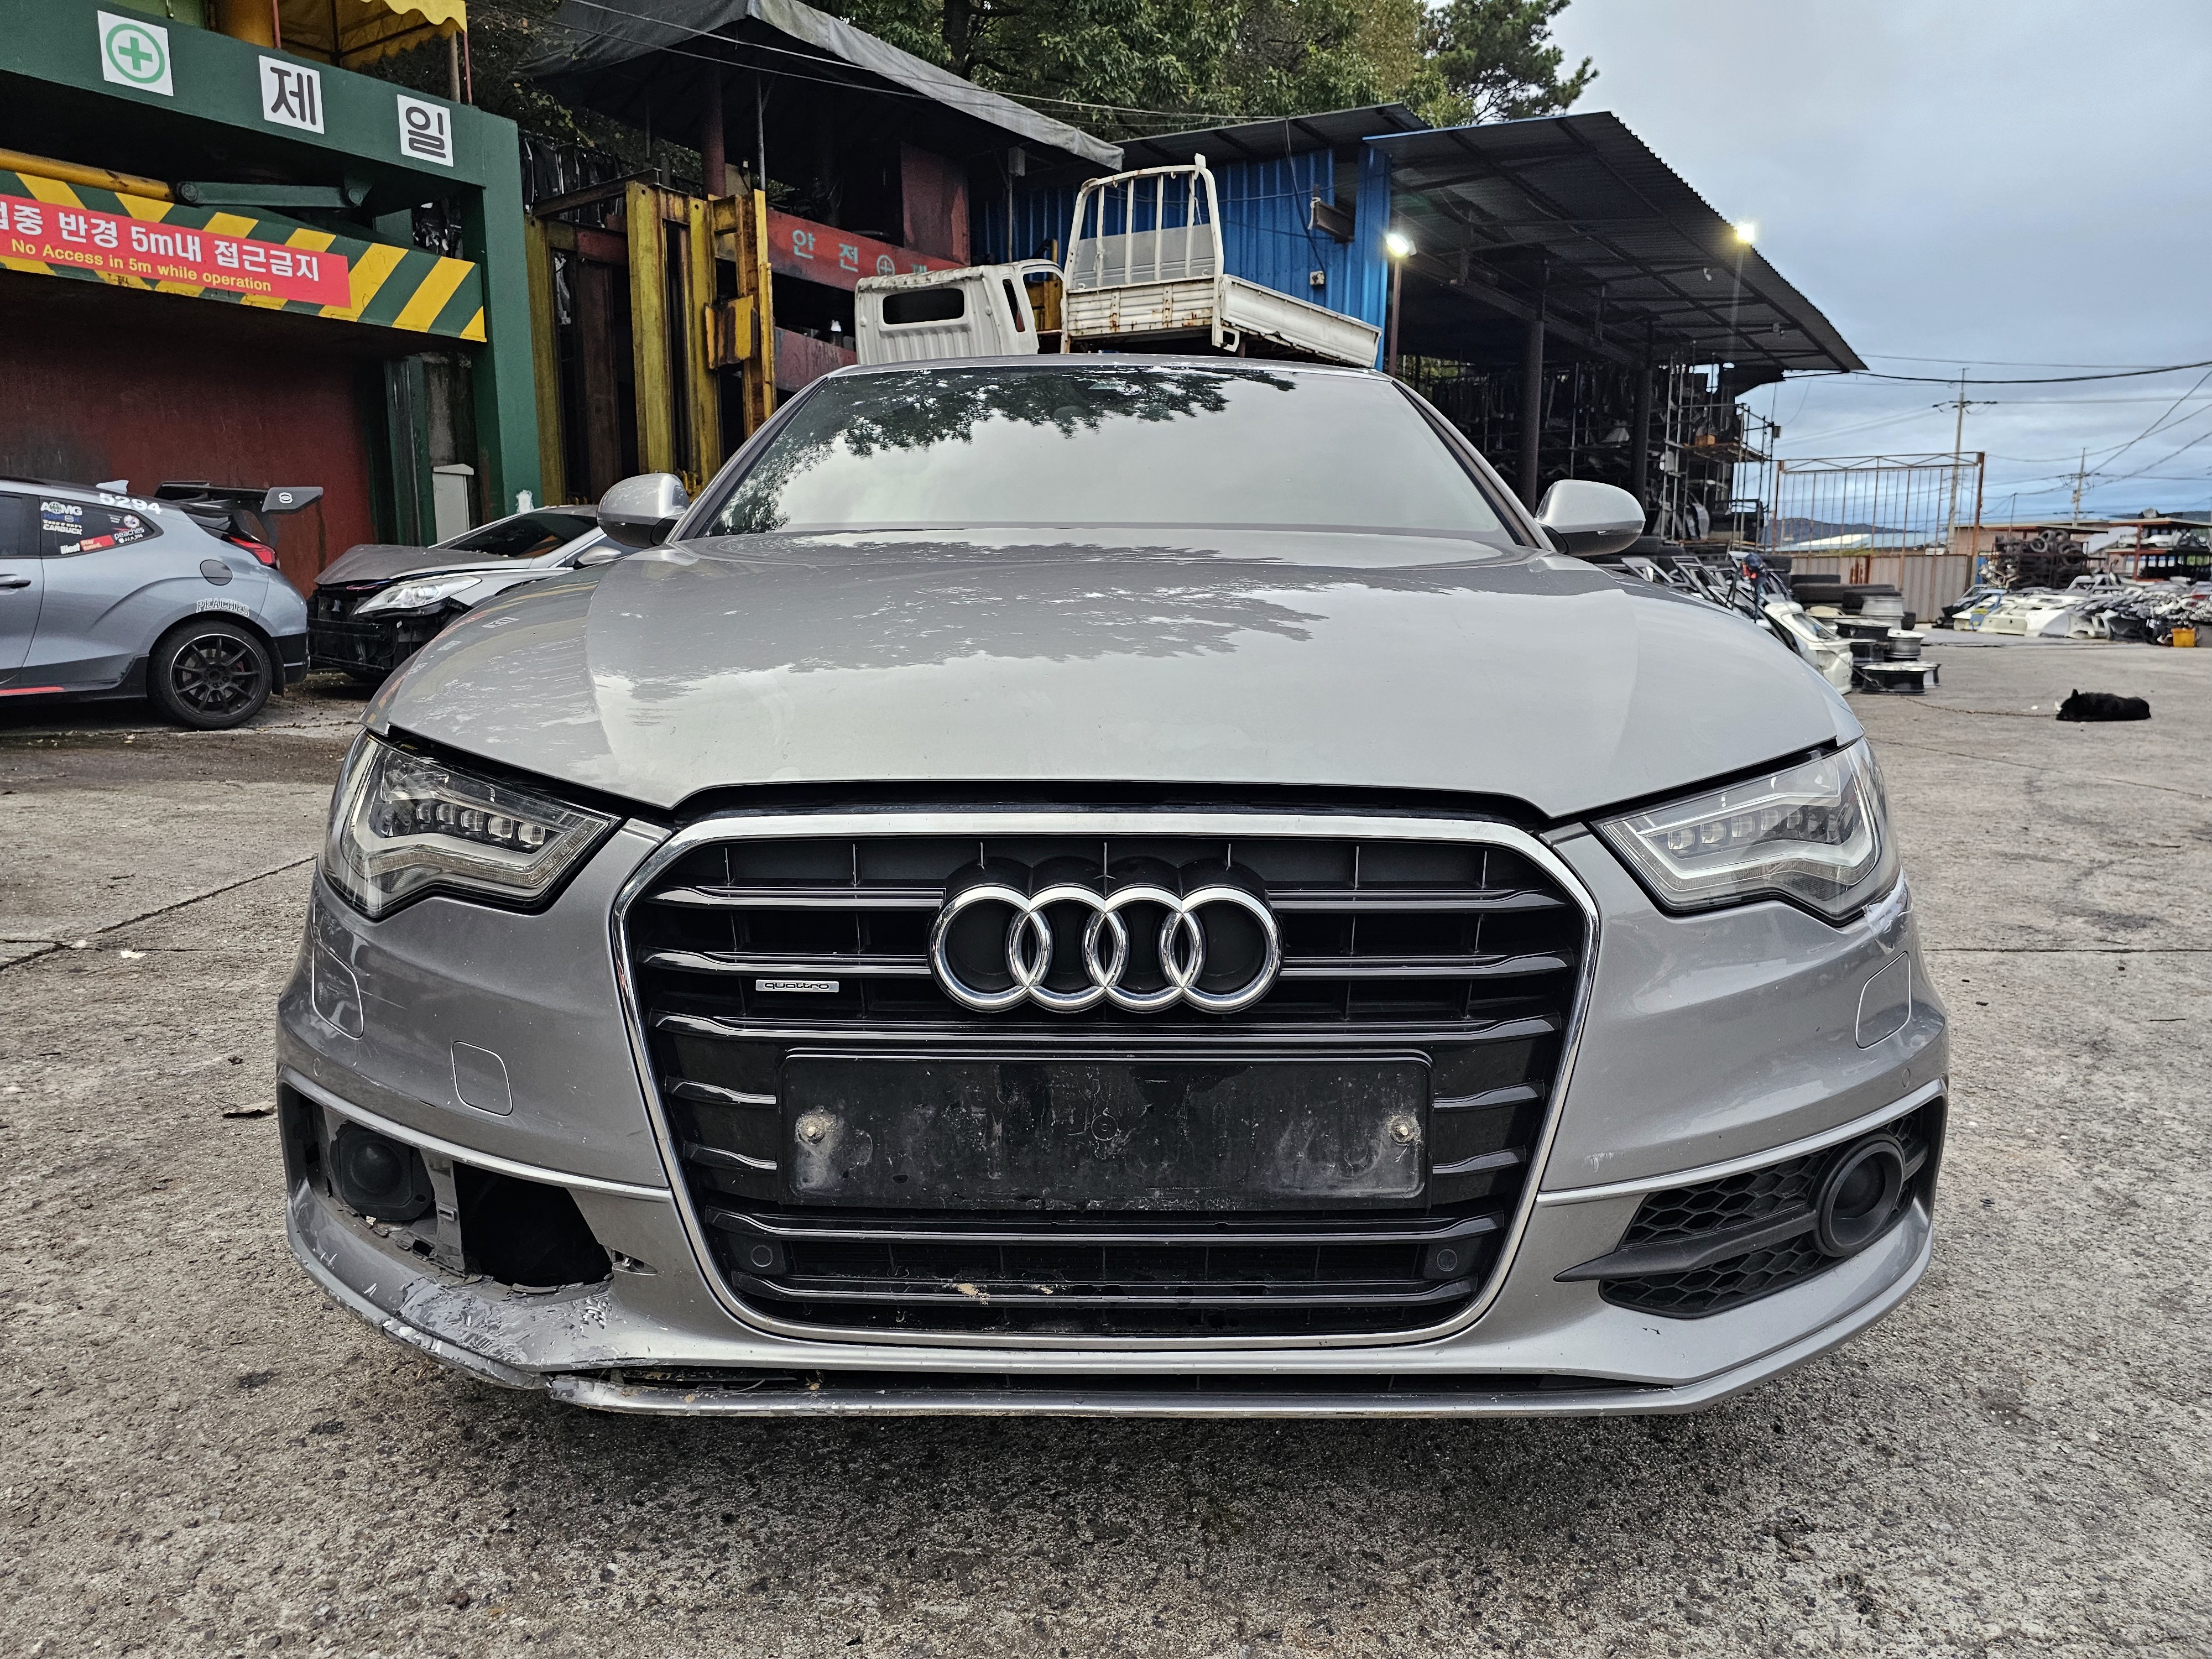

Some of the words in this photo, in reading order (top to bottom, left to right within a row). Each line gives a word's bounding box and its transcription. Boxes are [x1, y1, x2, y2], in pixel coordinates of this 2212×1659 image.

[270, 66, 317, 126] 제
[405, 106, 447, 159] 일
[12, 239, 36, 255] No
[43, 244, 103, 266] Access
[109, 254, 123, 269] in
[129, 258, 152, 273] 5m
[157, 264, 197, 280] while
[202, 272, 272, 292] operation
[58, 212, 118, 248] 반경
[131, 226, 202, 263] 5m내
[214, 239, 319, 281] 접근금지
[100, 493, 163, 515] 5294
[196, 597, 250, 618] PEACHES
